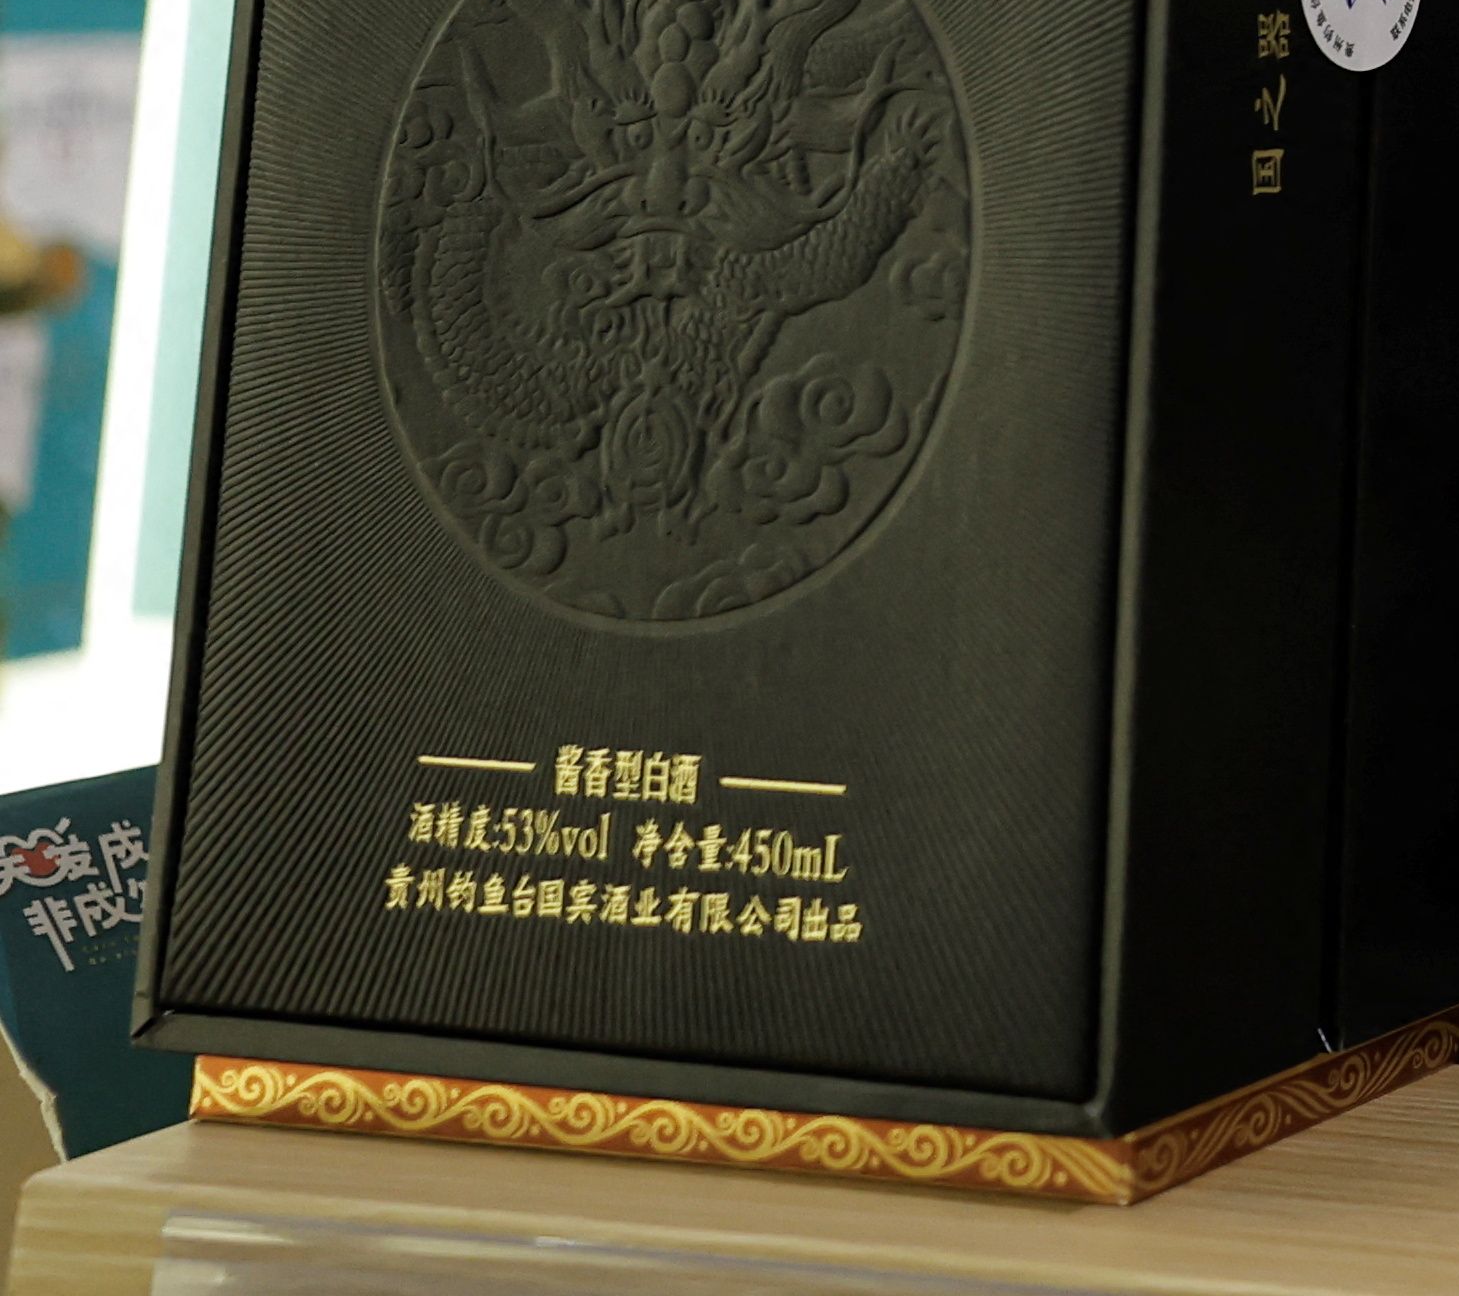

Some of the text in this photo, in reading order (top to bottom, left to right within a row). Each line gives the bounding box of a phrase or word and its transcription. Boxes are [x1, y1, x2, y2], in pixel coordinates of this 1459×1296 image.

[554, 745, 702, 805] 酱香型白酒
[385, 862, 864, 944] 贵州钓鱼台国宾酒业有限公司出品
